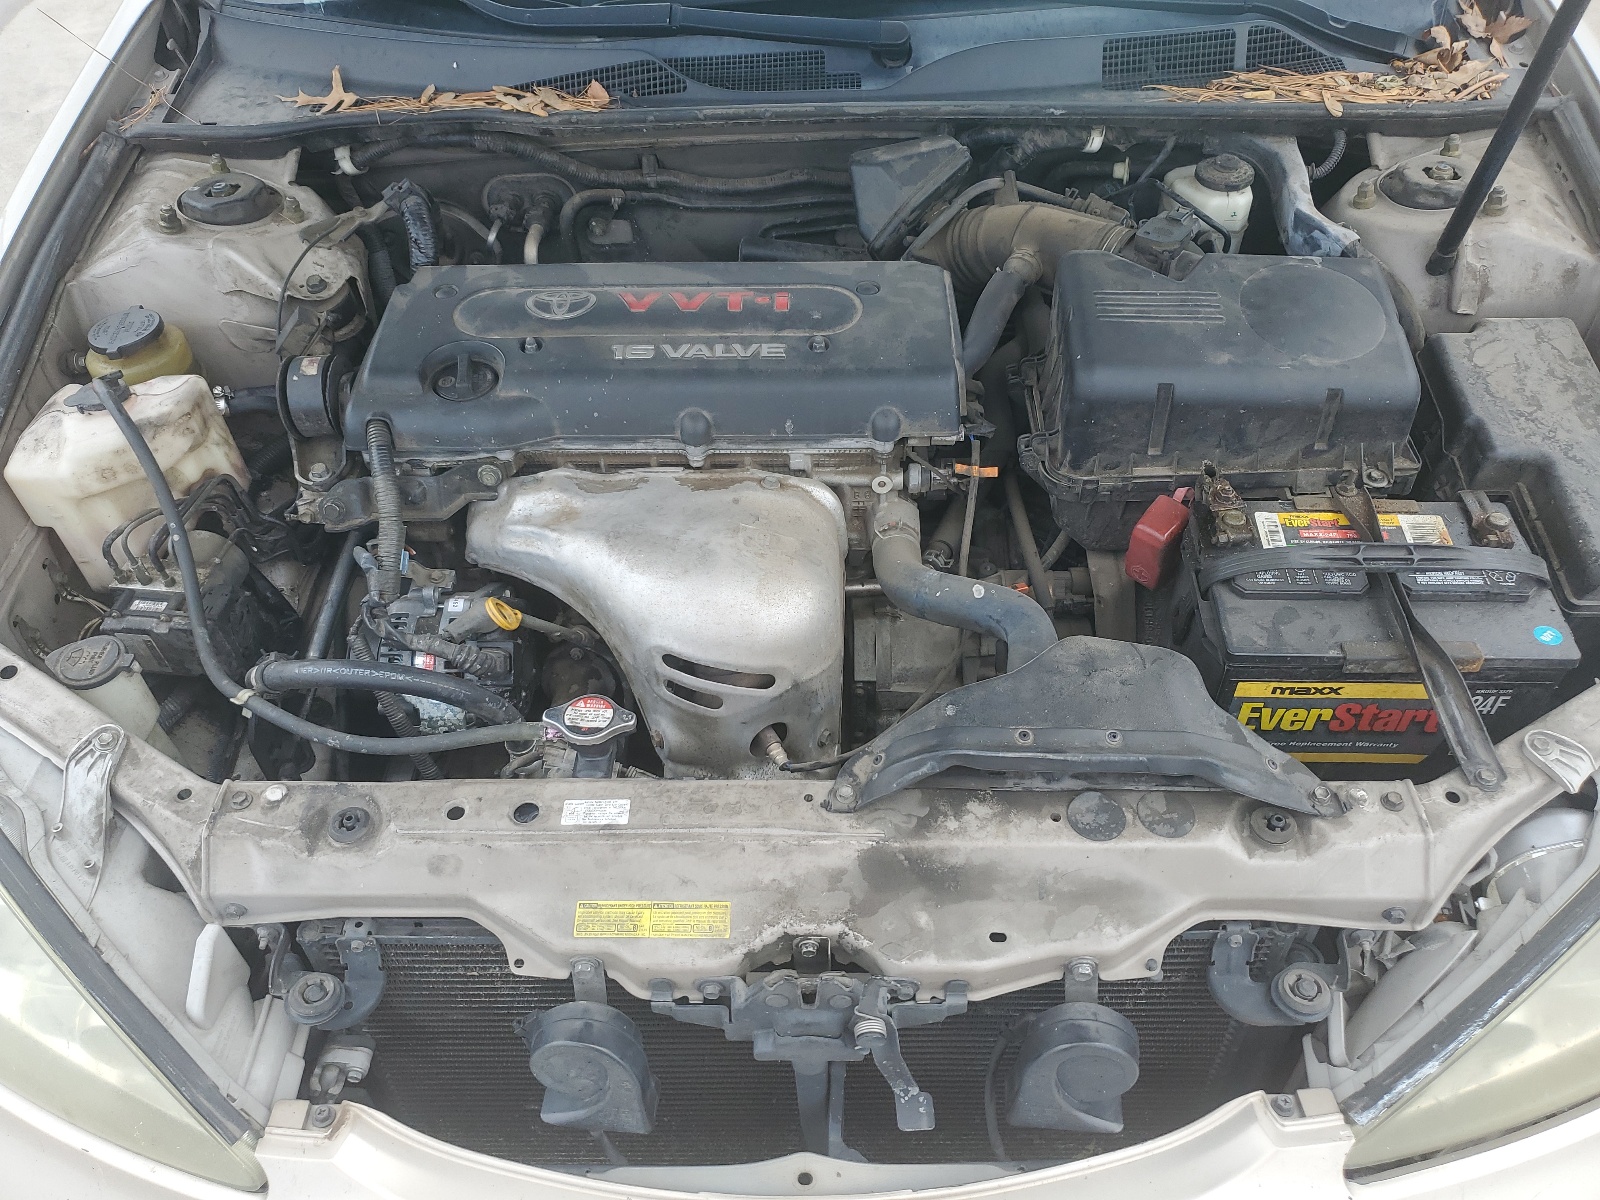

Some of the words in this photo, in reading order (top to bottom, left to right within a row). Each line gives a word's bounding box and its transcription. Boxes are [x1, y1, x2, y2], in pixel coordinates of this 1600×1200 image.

[617, 291, 790, 312] VVT-i
[611, 344, 655, 360] 16
[660, 343, 787, 360] VALVE
[1284, 517, 1340, 528] EverStart
[1270, 686, 1345, 696] maxx
[1237, 701, 1439, 733] EverStart
[1289, 740, 1353, 748] Replacement
[1355, 741, 1400, 749] Warranty
